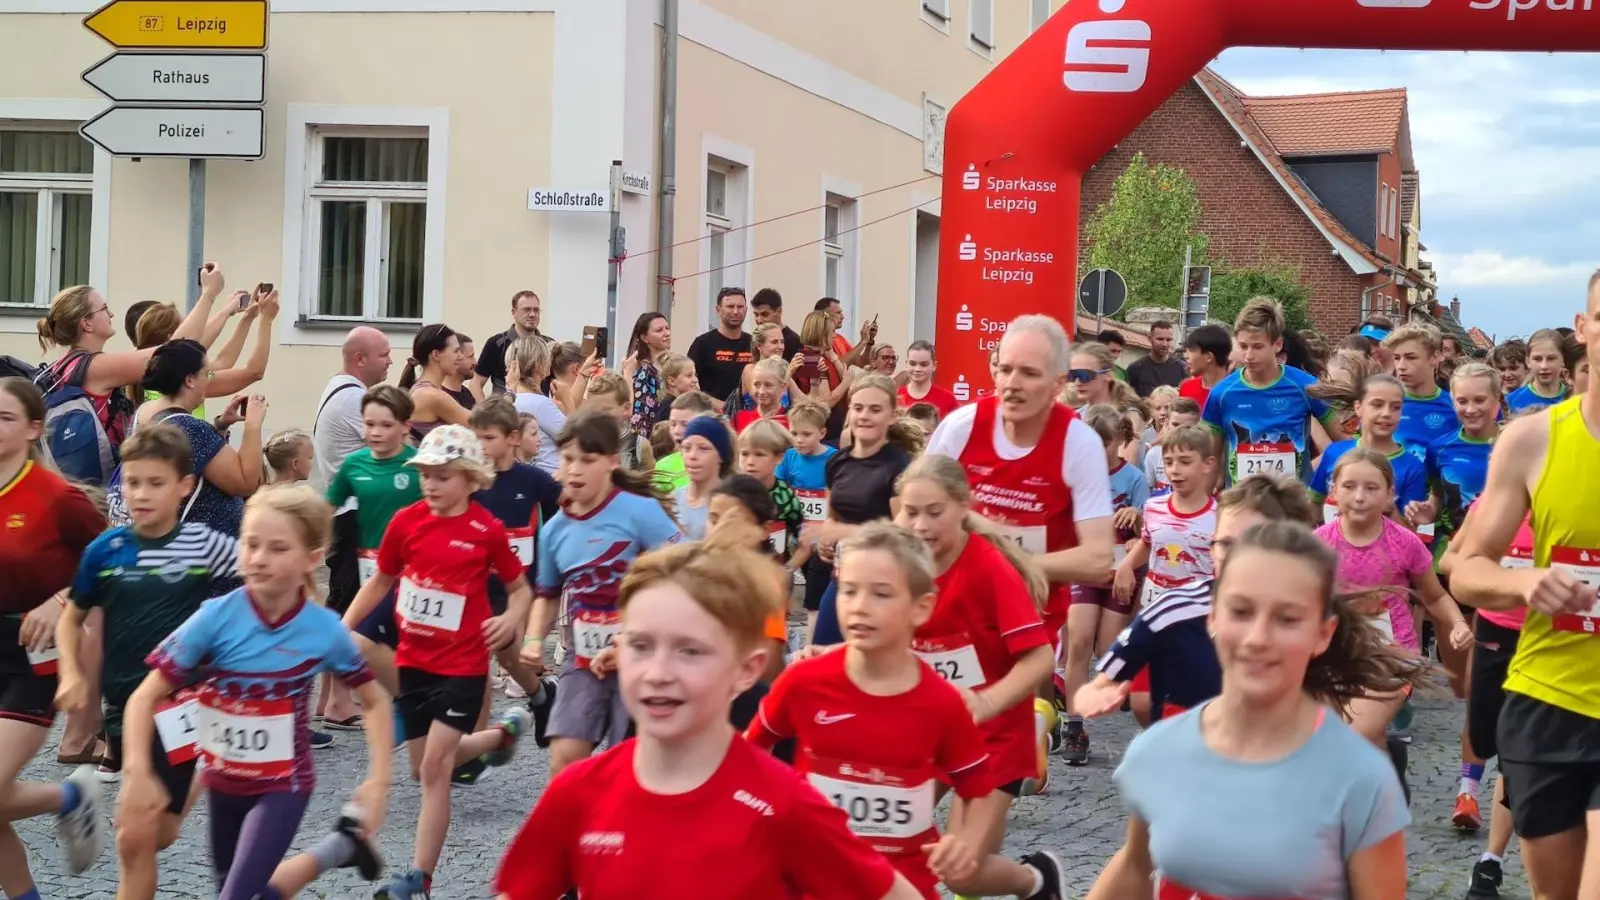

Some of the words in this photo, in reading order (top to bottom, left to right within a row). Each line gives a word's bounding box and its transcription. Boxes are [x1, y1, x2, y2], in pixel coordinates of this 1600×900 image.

[145, 18, 158, 30] 87
[177, 17, 226, 33] Leipzig
[153, 70, 210, 84] Rathaus
[158, 124, 205, 138] Polizei
[986, 176, 1057, 193] Sparkasse
[534, 191, 604, 207] Schloßstraße
[986, 196, 1037, 213] Leipzig
[983, 247, 1054, 263] Sparkasse
[982, 267, 1034, 284] Leipzig
[980, 318, 1011, 334] Spa
[1246, 459, 1285, 474] 2174
